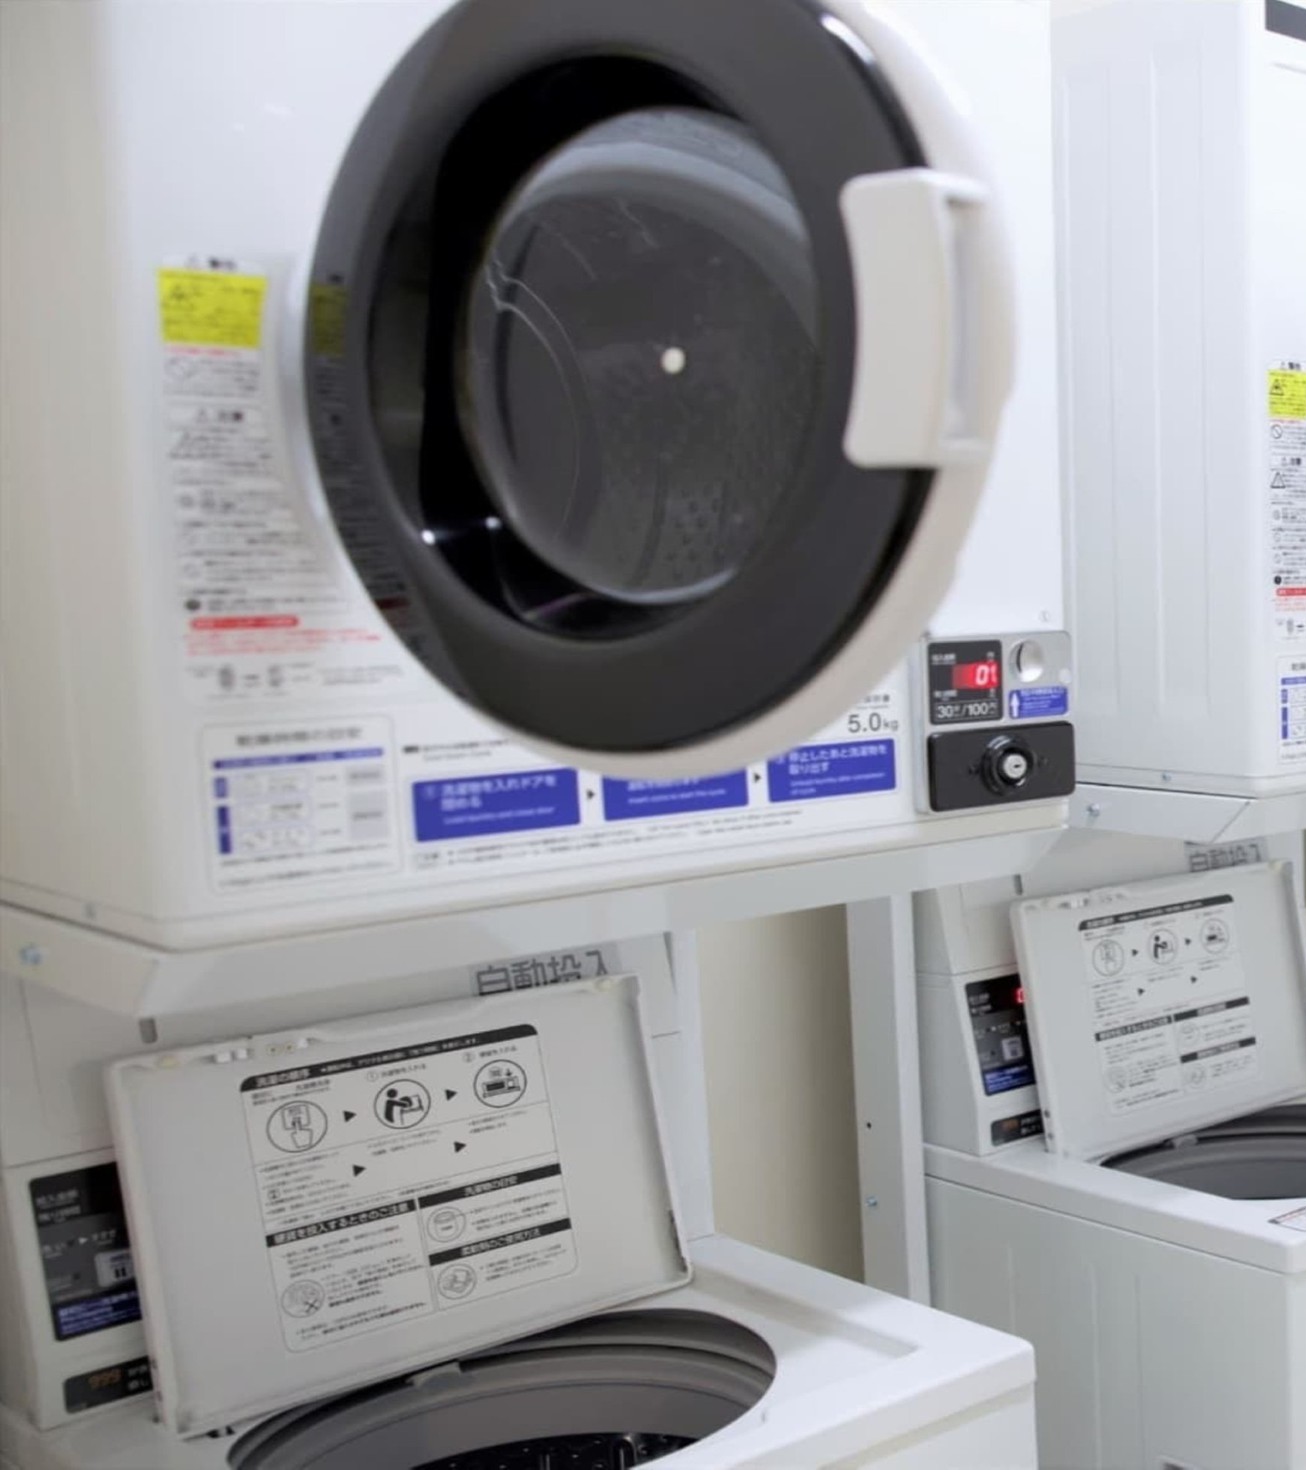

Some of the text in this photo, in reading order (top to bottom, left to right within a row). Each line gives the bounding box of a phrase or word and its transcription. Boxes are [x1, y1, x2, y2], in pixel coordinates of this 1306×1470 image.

[848, 712, 899, 733] 5.0kg
[476, 949, 608, 996] 自動投入
